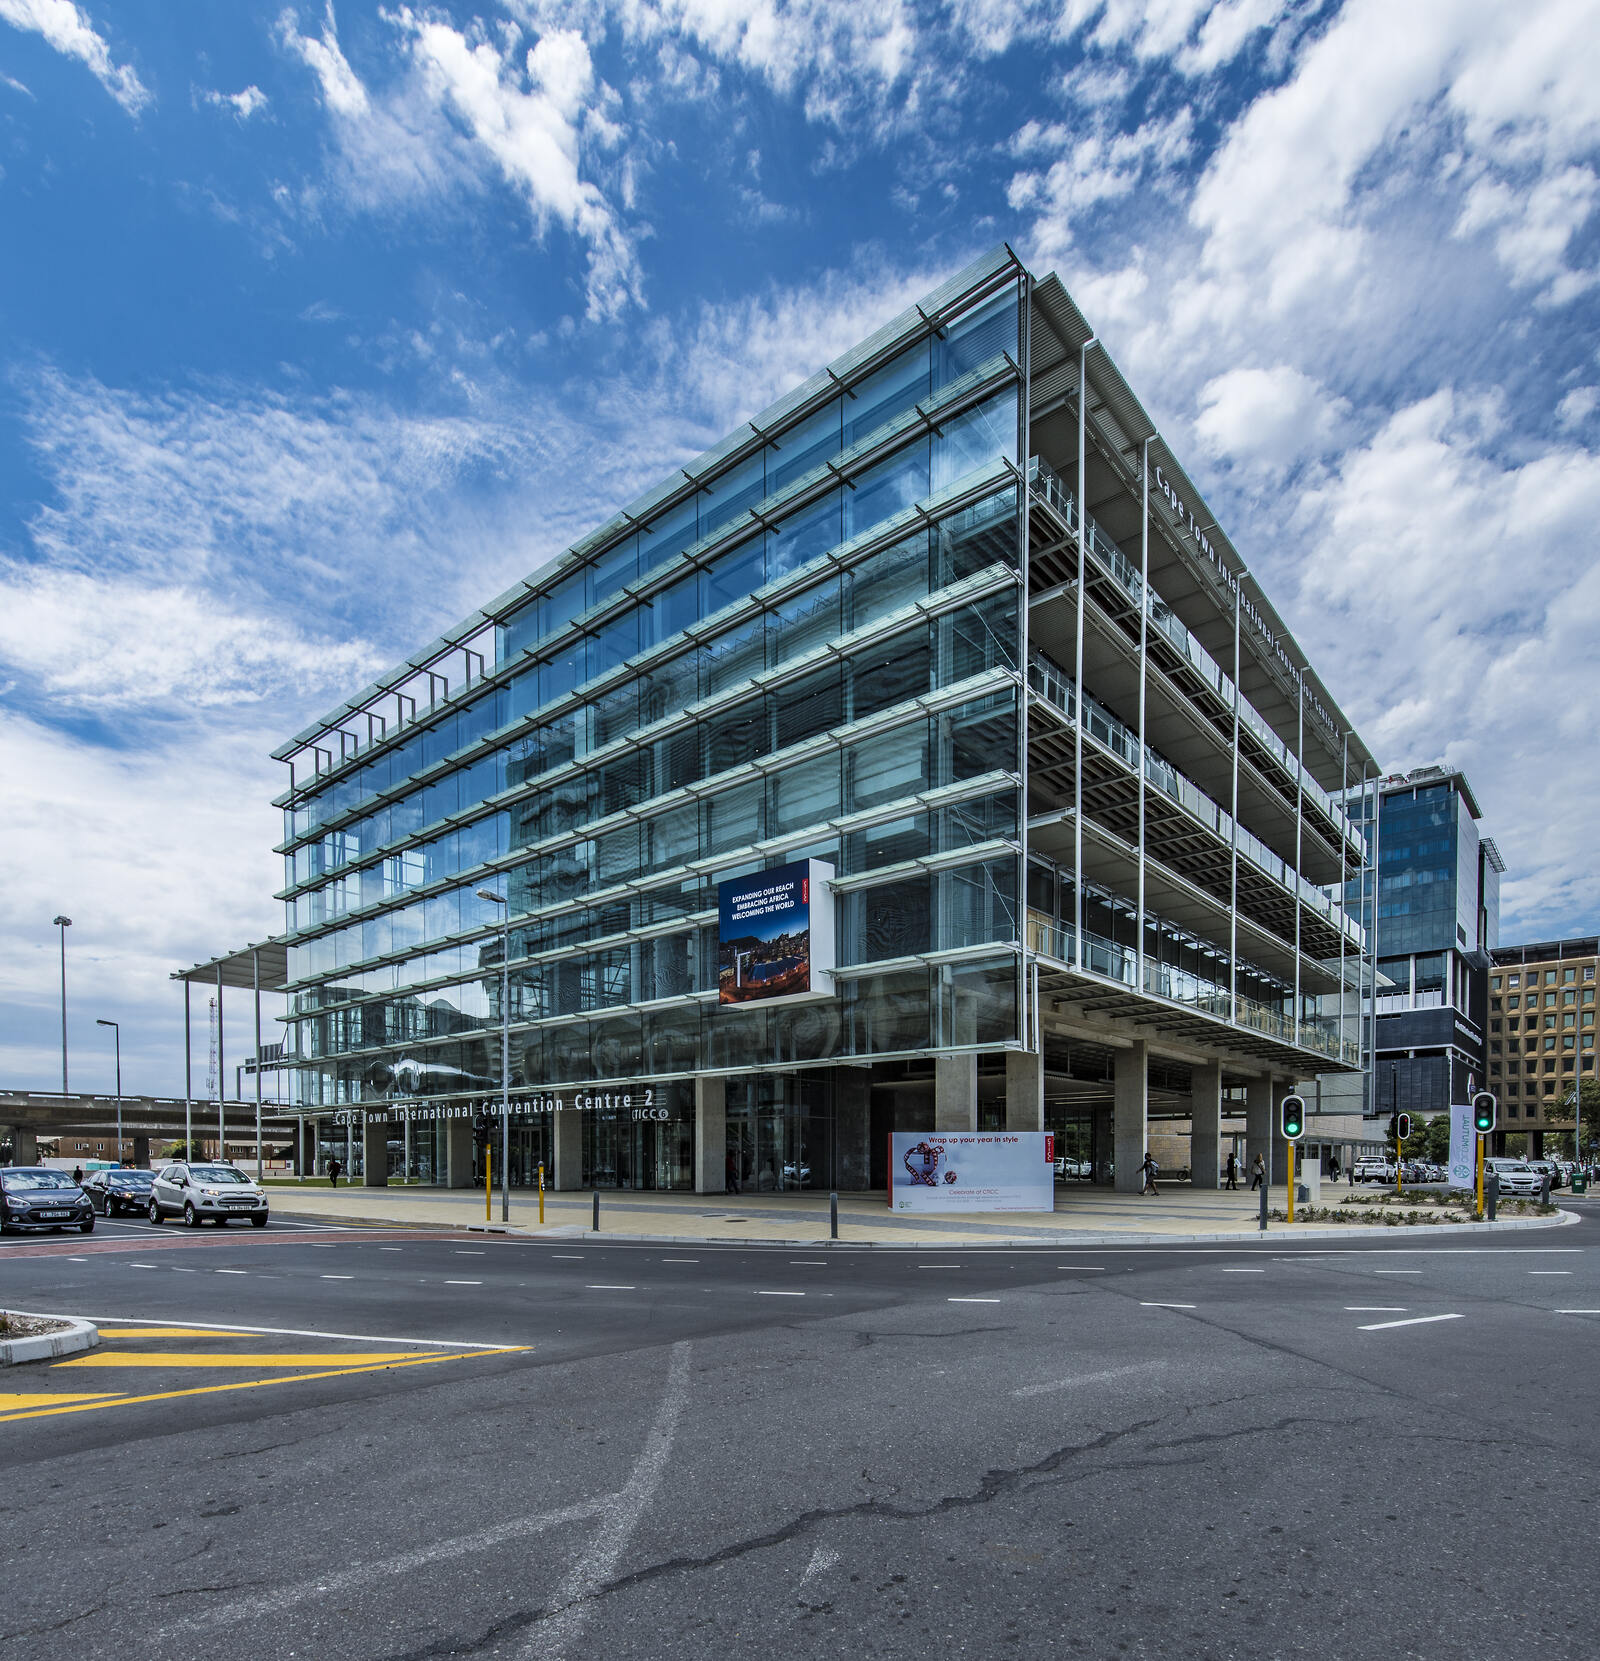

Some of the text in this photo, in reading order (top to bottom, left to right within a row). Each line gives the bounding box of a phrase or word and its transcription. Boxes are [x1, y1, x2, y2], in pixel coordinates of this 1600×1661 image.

[1156, 466, 1184, 518] Cape
[1189, 511, 1215, 562] Town
[1219, 555, 1274, 648] Intenational
[732, 882, 794, 904] EXPANDING OUR REACH
[736, 893, 789, 911] EMBRACING AFRICA
[731, 900, 795, 921] WELCOMING THE WORLD
[335, 1113, 357, 1128] Cape
[395, 1102, 473, 1121] International
[482, 1097, 563, 1116] Convention
[574, 1093, 631, 1110] Centre
[645, 1089, 653, 1106] 2
[631, 1108, 657, 1120] CTICC
[1002, 1136, 1019, 1144] style
